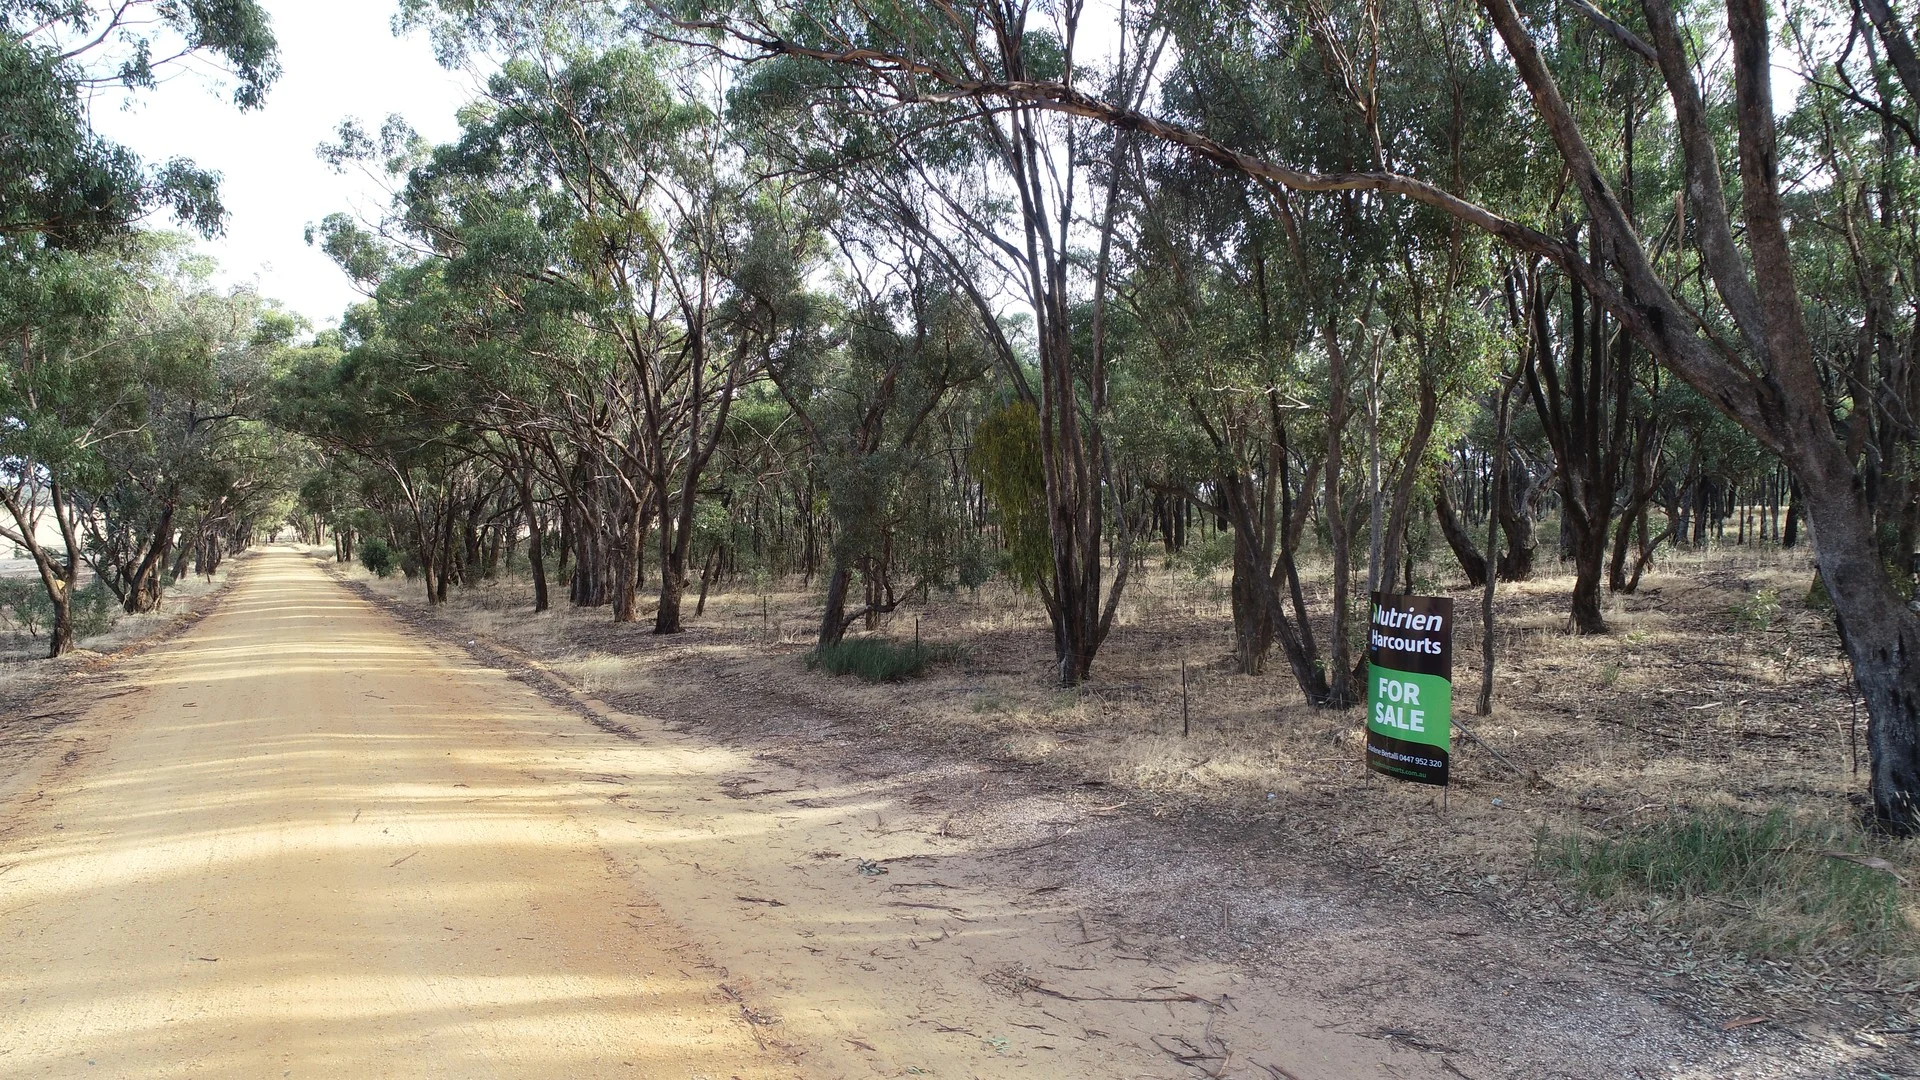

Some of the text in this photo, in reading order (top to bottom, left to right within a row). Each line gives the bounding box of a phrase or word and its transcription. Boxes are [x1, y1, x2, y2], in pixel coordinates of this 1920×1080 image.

[1372, 603, 1443, 632] Nutrien
[1371, 629, 1442, 655] Harcourts
[1378, 677, 1420, 706] FOR
[1375, 701, 1425, 733] SALE
[1399, 754, 1414, 763] 0447
[1415, 757, 1428, 766] 952
[1429, 760, 1443, 769] 320
